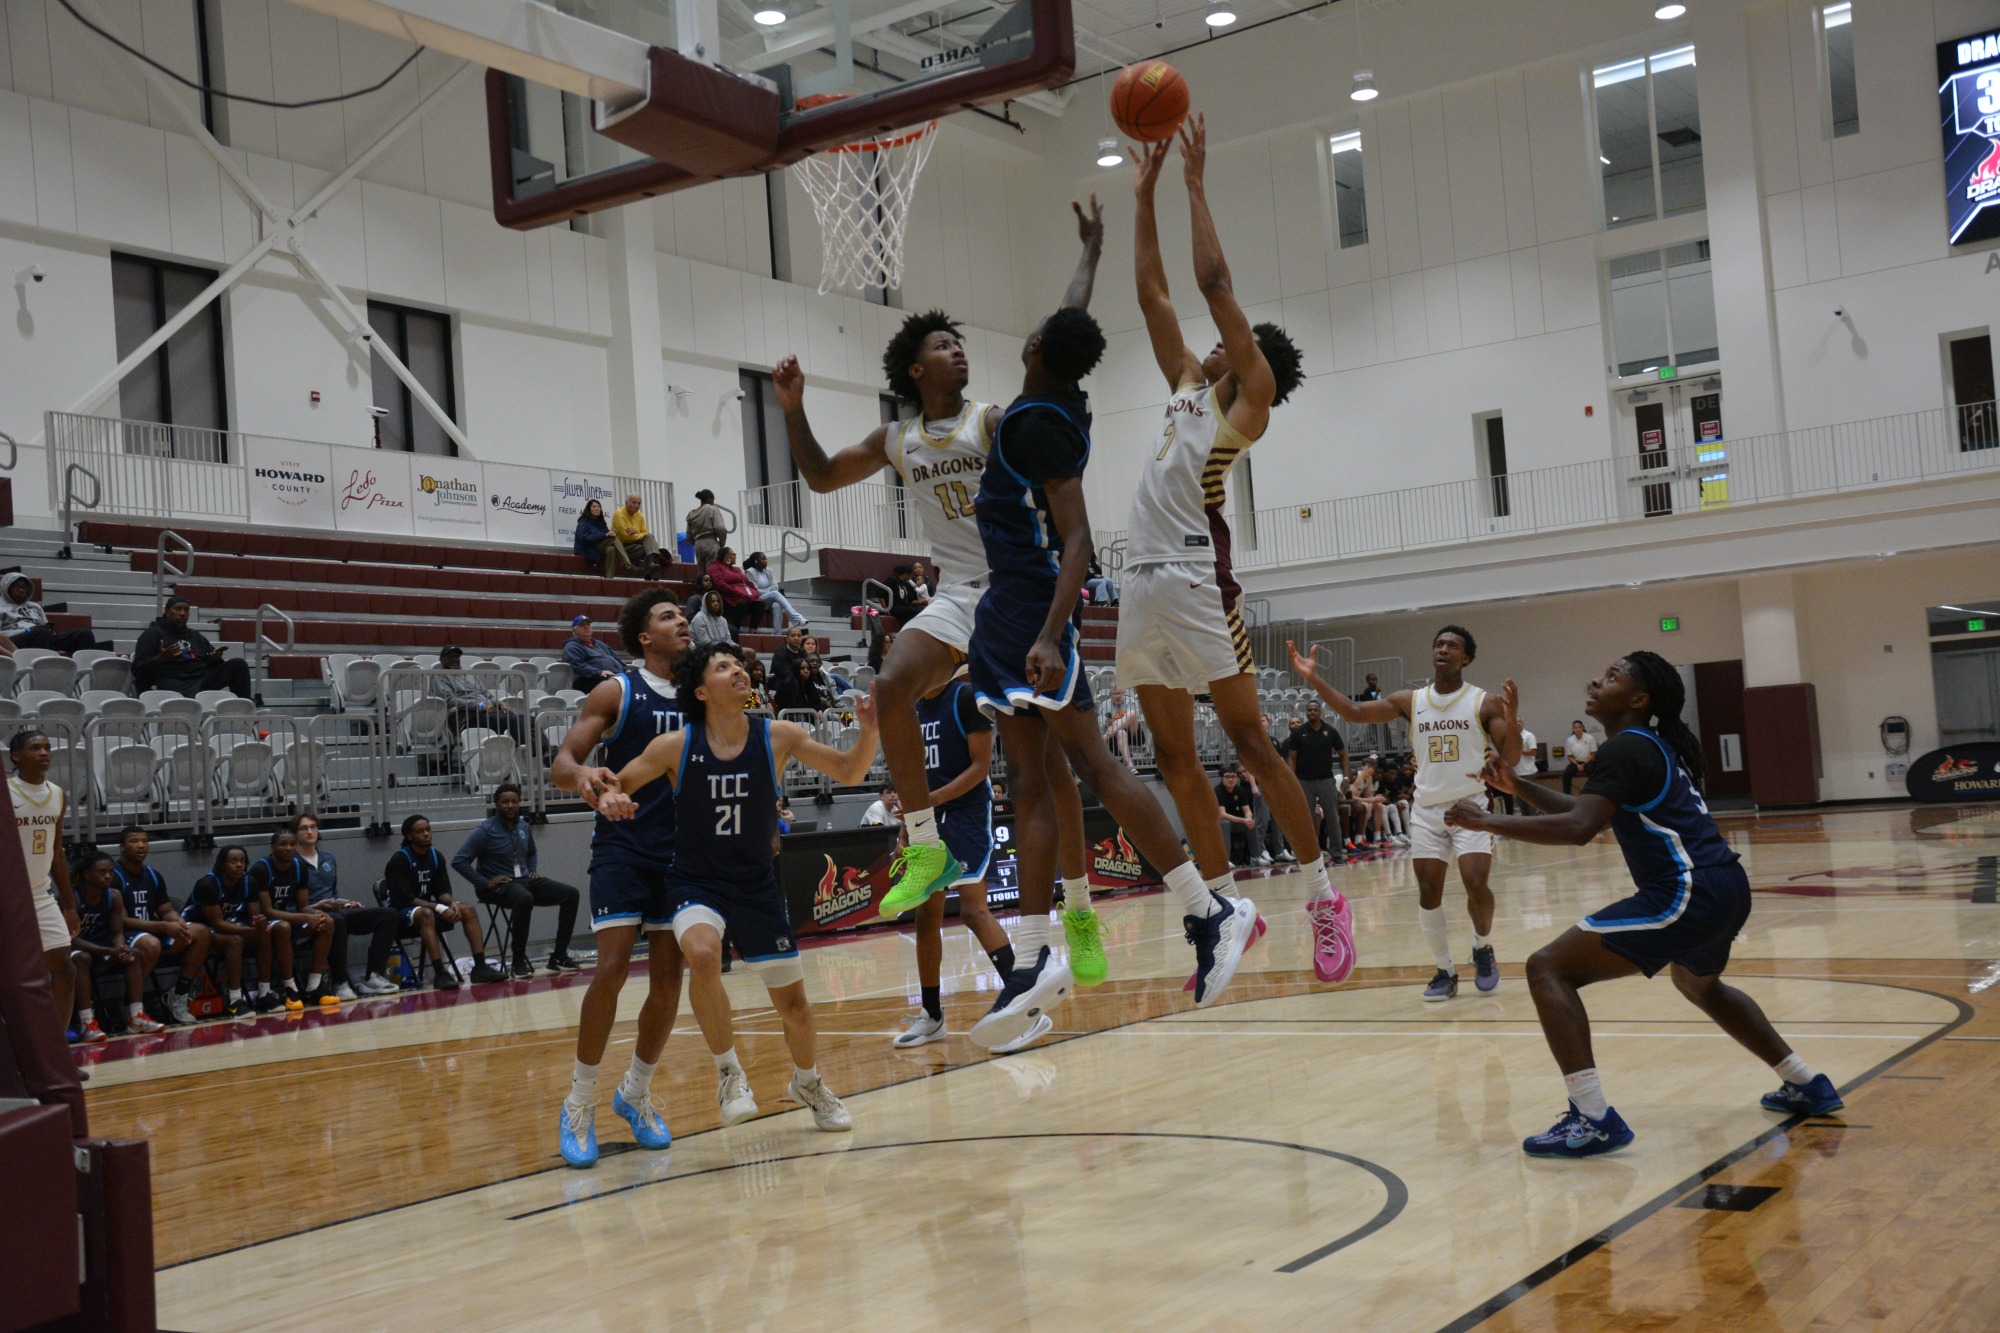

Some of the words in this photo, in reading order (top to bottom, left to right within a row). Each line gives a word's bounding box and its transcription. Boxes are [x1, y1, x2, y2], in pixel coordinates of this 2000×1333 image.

[1957, 34, 2000, 65] DRA
[255, 468, 325, 483] HOWARD
[912, 457, 984, 482] DRAGONS
[272, 484, 311, 494] COUNTY
[341, 469, 376, 510] Ledo
[417, 474, 477, 494] Jonathan
[367, 493, 405, 509] Pizza
[434, 490, 477, 506] Johnson
[502, 495, 546, 515] Academy
[934, 480, 976, 520] 11
[1418, 720, 1469, 733] DRAGONS
[1428, 735, 1460, 763] 23
[707, 773, 749, 799] TCC
[1954, 779, 2000, 791] HOWAR
[715, 804, 741, 835] 21
[32, 829, 47, 854] 2
[995, 826, 1010, 842] 9
[1094, 857, 1141, 876] DRAGONS
[1001, 878, 1008, 886] 1
[813, 884, 872, 920] DRAGONS
[992, 890, 1020, 902] FOULS
[202, 1002, 211, 1013] G
